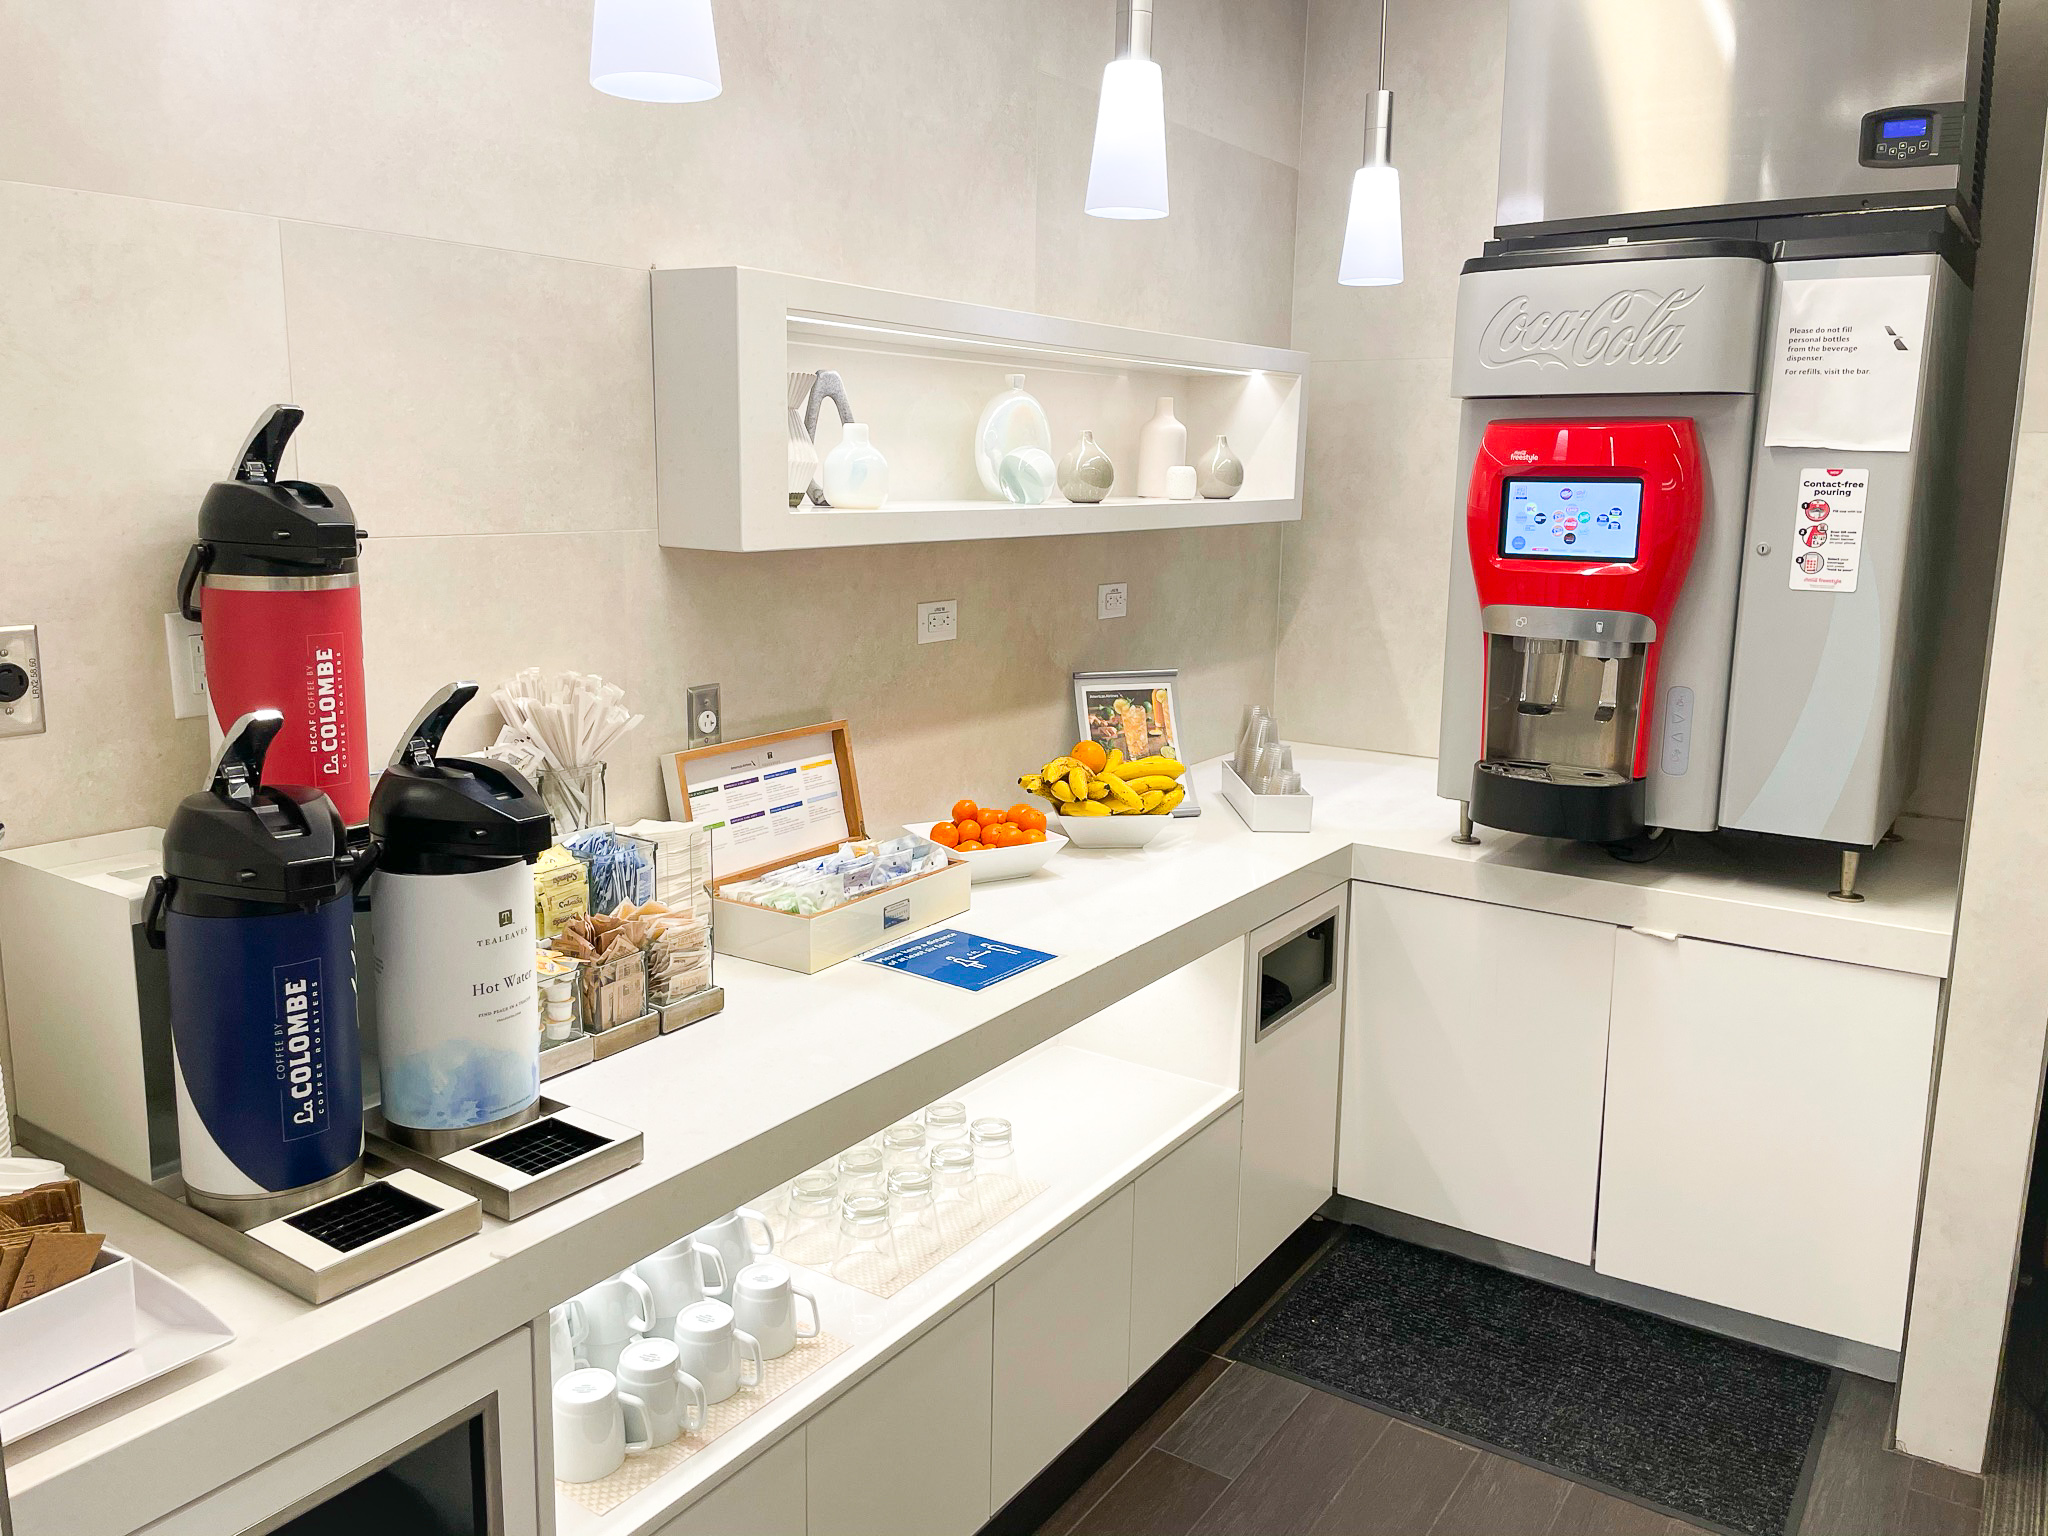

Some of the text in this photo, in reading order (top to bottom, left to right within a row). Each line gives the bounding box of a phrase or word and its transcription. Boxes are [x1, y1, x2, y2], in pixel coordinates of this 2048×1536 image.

[1478, 284, 1705, 371] Coca-Cola
[1786, 355, 1824, 363] dispenser.
[1822, 345, 1858, 353] beverage
[1510, 453, 1539, 463] freestyle
[1803, 480, 1864, 489] Contact-free
[1813, 488, 1852, 497] pouring
[31, 679, 40, 699] LRX2
[306, 665, 318, 752] DECAF COFFEE BY
[315, 648, 340, 775] La COLOMBE
[335, 652, 348, 769] COFFEE ROASTERS
[476, 926, 528, 947] TEALEAVES
[472, 969, 532, 997] Hot Water
[478, 1010, 492, 1018] FIND
[273, 1023, 286, 1081] COFFEE BY
[285, 978, 314, 1125] La COLOMBE
[312, 981, 325, 1115] COFFEE ROASTERS
